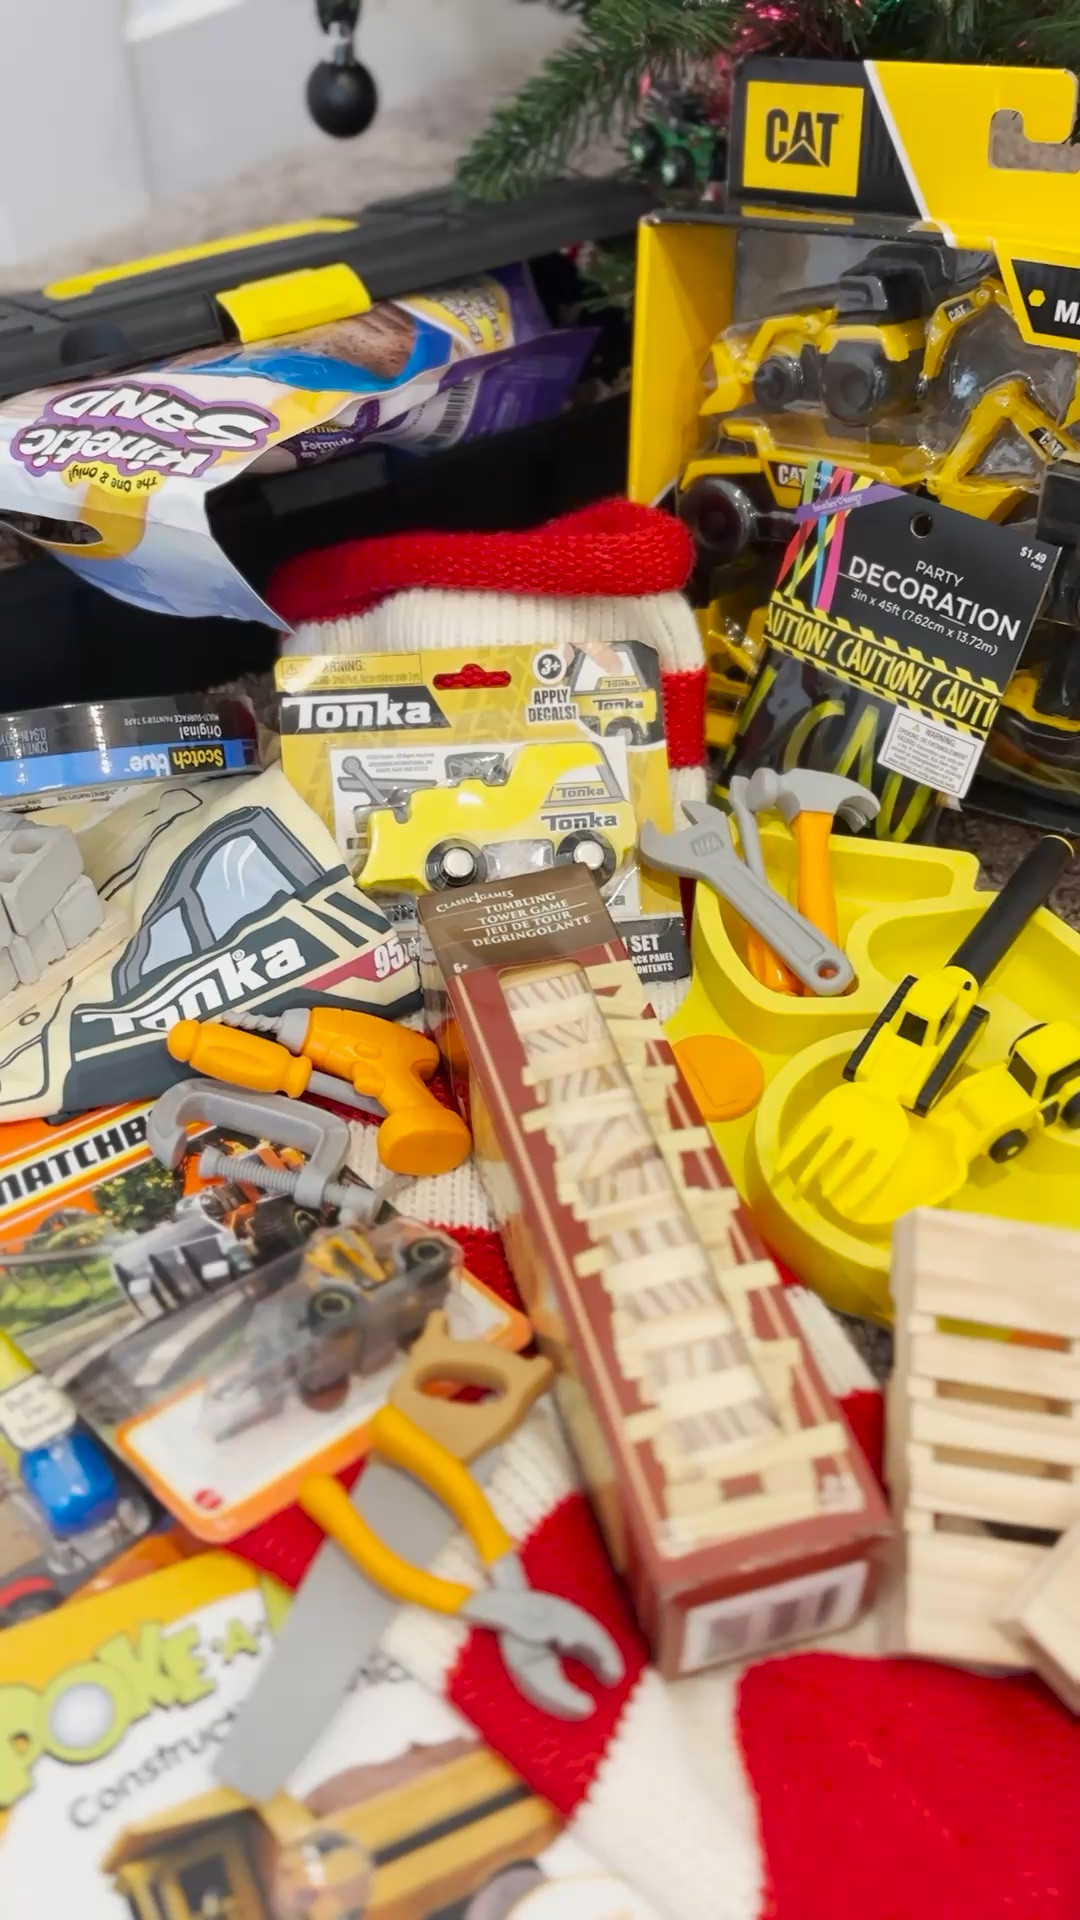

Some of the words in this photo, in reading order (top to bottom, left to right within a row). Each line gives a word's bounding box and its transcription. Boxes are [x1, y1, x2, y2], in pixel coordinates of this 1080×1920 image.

[766, 108, 840, 168] CAT
[947, 303, 966, 323] CAT
[68, 464, 98, 483] Only!
[99, 471, 108, 484] &
[136, 475, 158, 490] The
[778, 463, 805, 489] CAT
[110, 476, 131, 492] One
[1019, 546, 1047, 564] $1.49
[915, 560, 965, 587] PARTY
[848, 555, 1022, 642] DECORATION
[851, 587, 868, 603] 3in
[869, 596, 876, 607] x
[878, 598, 902, 617] 45ft
[902, 609, 946, 635] (7.62cm
[945, 627, 954, 638] x
[956, 630, 998, 656] 13.72m)
[322, 659, 366, 673] ARNING:
[540, 657, 560, 676] 3+
[766, 603, 838, 659] AUTION!
[836, 638, 933, 699] CAUTION!
[931, 680, 999, 729] CAUTI
[605, 679, 637, 688] Tonka
[534, 688, 569, 705] APPLY
[592, 698, 644, 711] Tonka
[282, 692, 432, 729] Tonka
[528, 704, 577, 722] DECALS!
[179, 723, 222, 740] Original
[172, 748, 223, 770] Scotch
[556, 786, 605, 799] Tonka
[541, 811, 618, 831] Tonka
[436, 894, 477, 913] CLASSIC
[480, 889, 515, 901] GAMES
[484, 892, 557, 914] TUMBLING
[478, 906, 528, 926] TOWER
[529, 898, 569, 915] GAME
[472, 915, 592, 947] DEGRINGOLANTE
[485, 921, 508, 937] JEU
[512, 918, 531, 931] DE
[530, 910, 572, 926] TOUR
[630, 933, 660, 953] SET
[374, 936, 411, 978] 95
[631, 954, 649, 965] ACK
[649, 952, 674, 963] PANEL
[453, 962, 469, 974] 6+
[636, 962, 673, 975] ONTENTS
[81, 937, 307, 1036] Tonka
[0, 1114, 152, 1205] MATCHB
[70, 1709, 238, 1830] Construc
